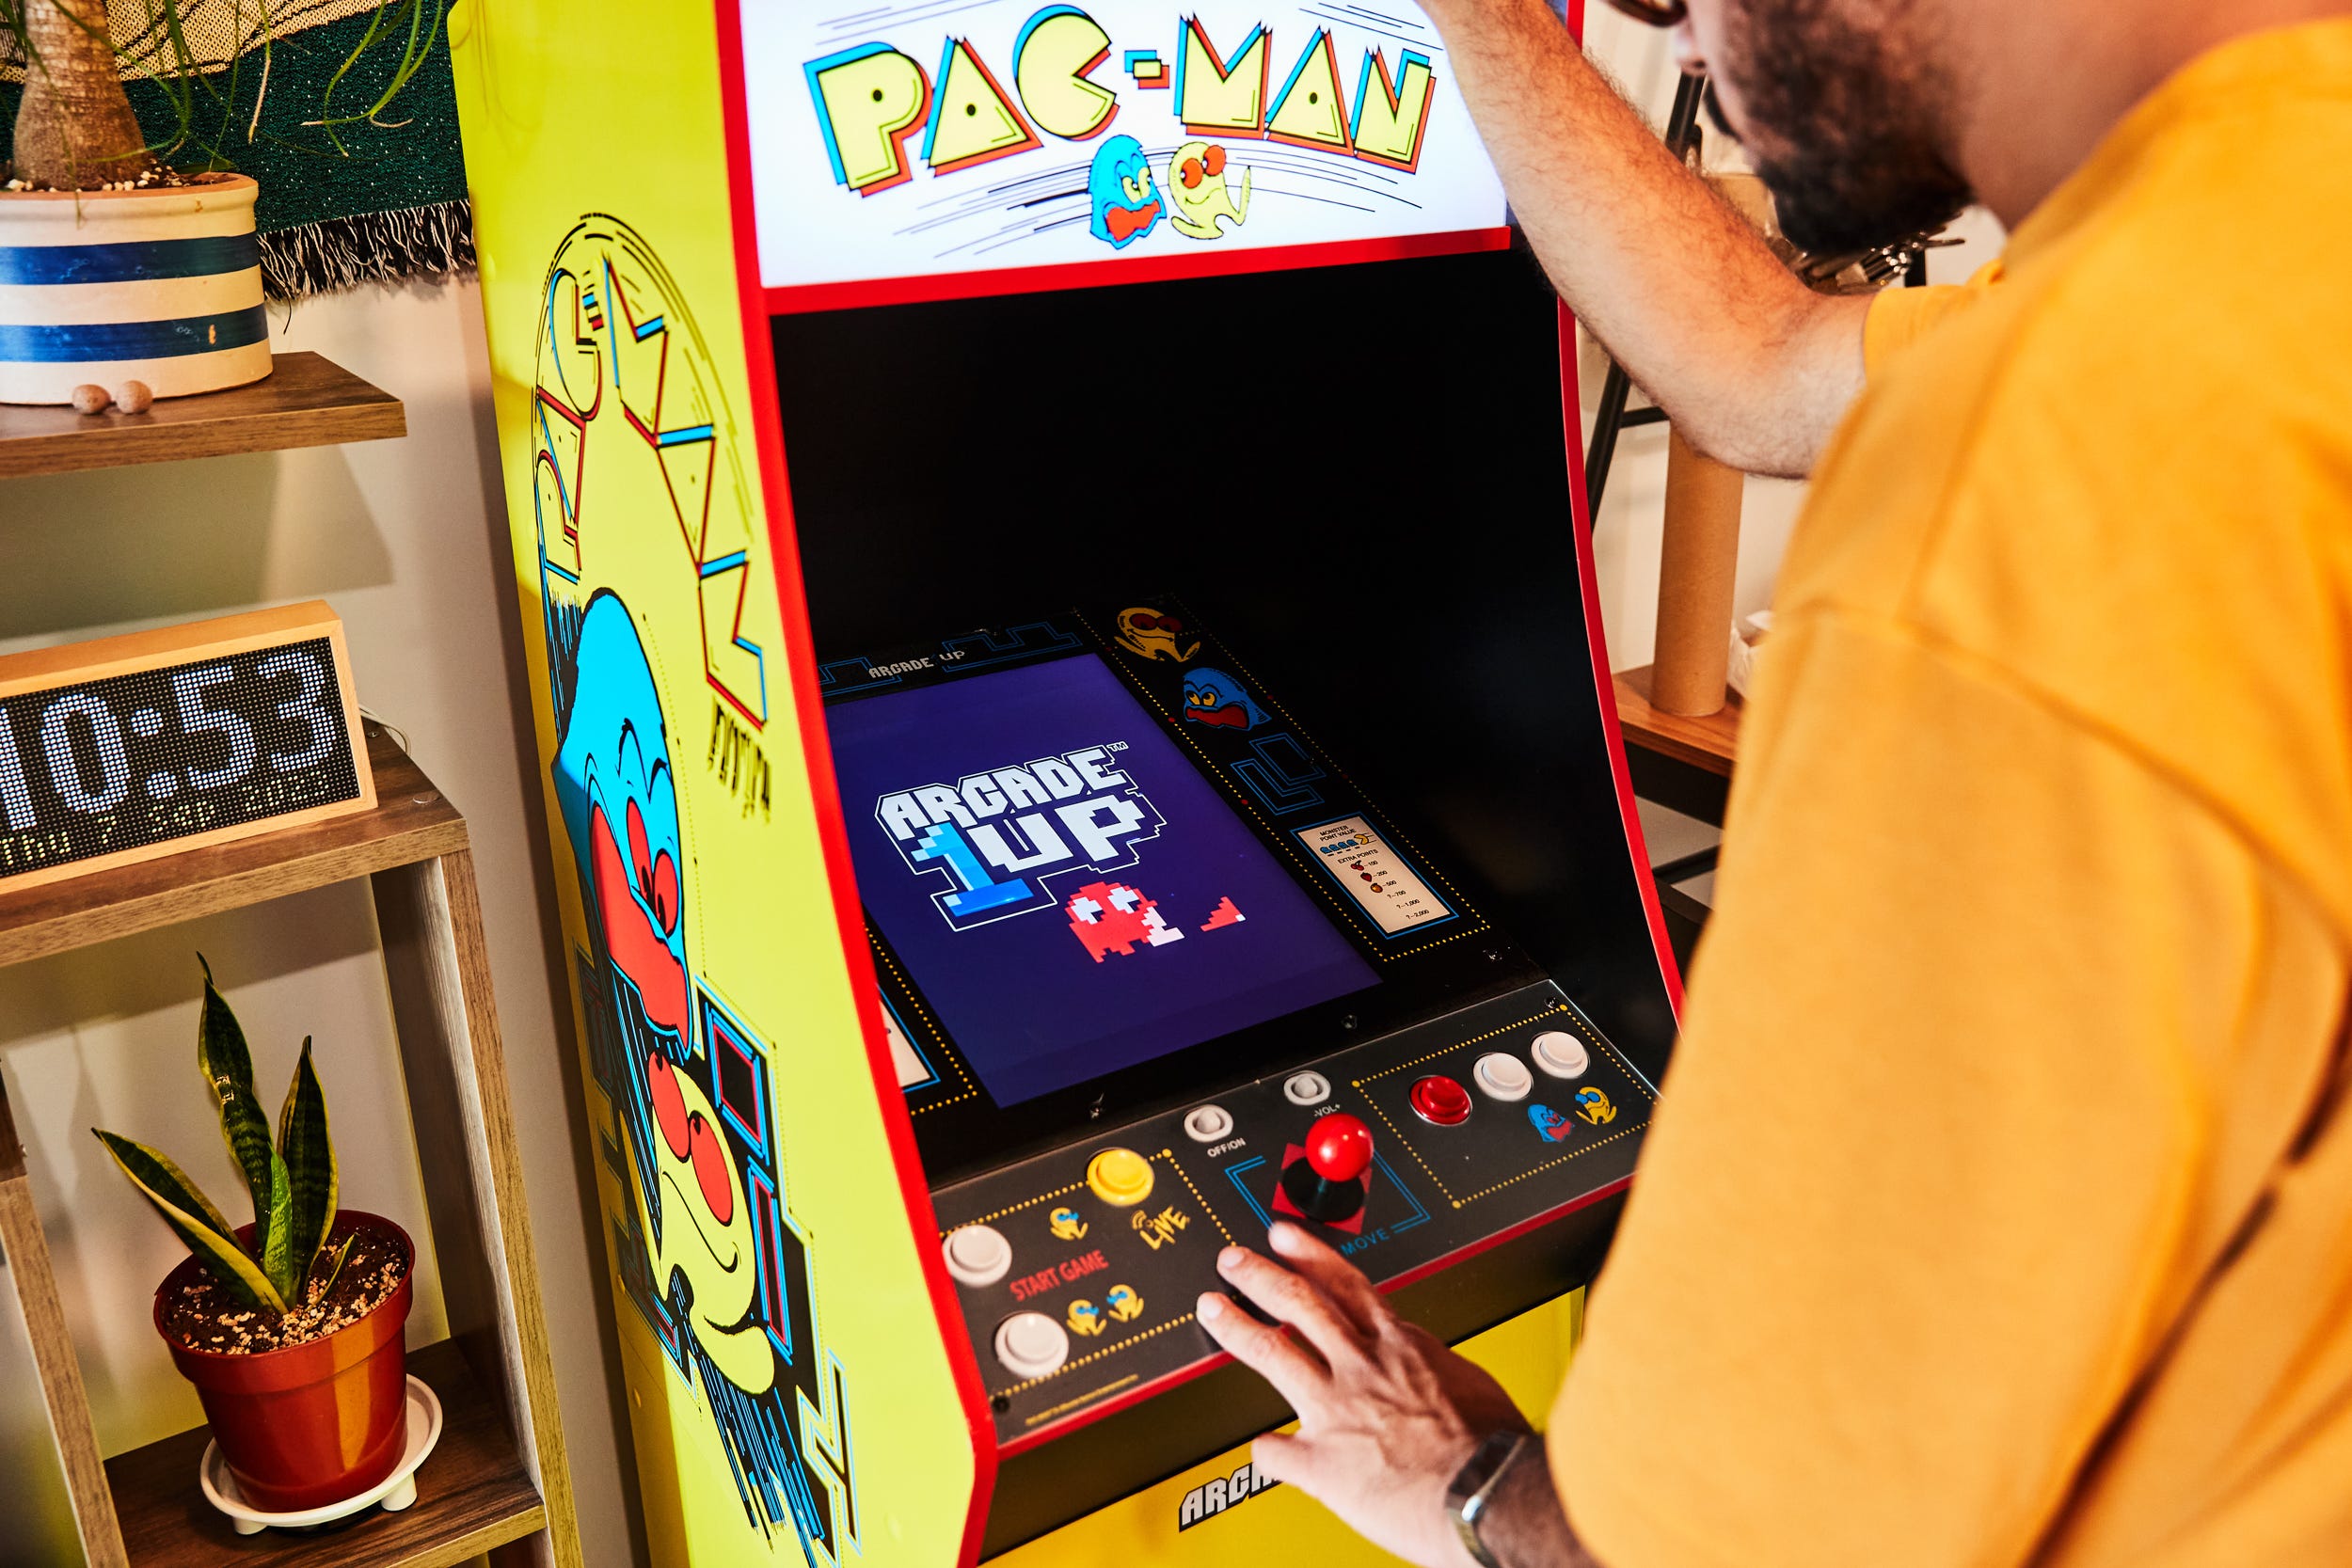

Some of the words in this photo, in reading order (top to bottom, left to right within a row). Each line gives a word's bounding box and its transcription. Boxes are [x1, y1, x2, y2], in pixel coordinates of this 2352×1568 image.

[803, 3, 1437, 198] PAC-MAN
[868, 657, 934, 678] ARCADE
[97, 814, 117, 845] 7
[148, 800, 215, 833] Sep
[241, 770, 329, 812] 2023
[880, 747, 1128, 841] ARCADE
[1319, 825, 1349, 836] MONSTER
[1319, 832, 1337, 842] POINT
[1337, 828, 1357, 837] VALUE
[911, 794, 1146, 918] 1UP
[1337, 855, 1358, 864] EXTRA
[1357, 849, 1378, 858] POINTS
[1207, 1137, 1247, 1158] OFF/ON
[1340, 1227, 1391, 1257] MOVE
[1009, 1267, 1061, 1303] START
[1058, 1248, 1110, 1283] GAME
